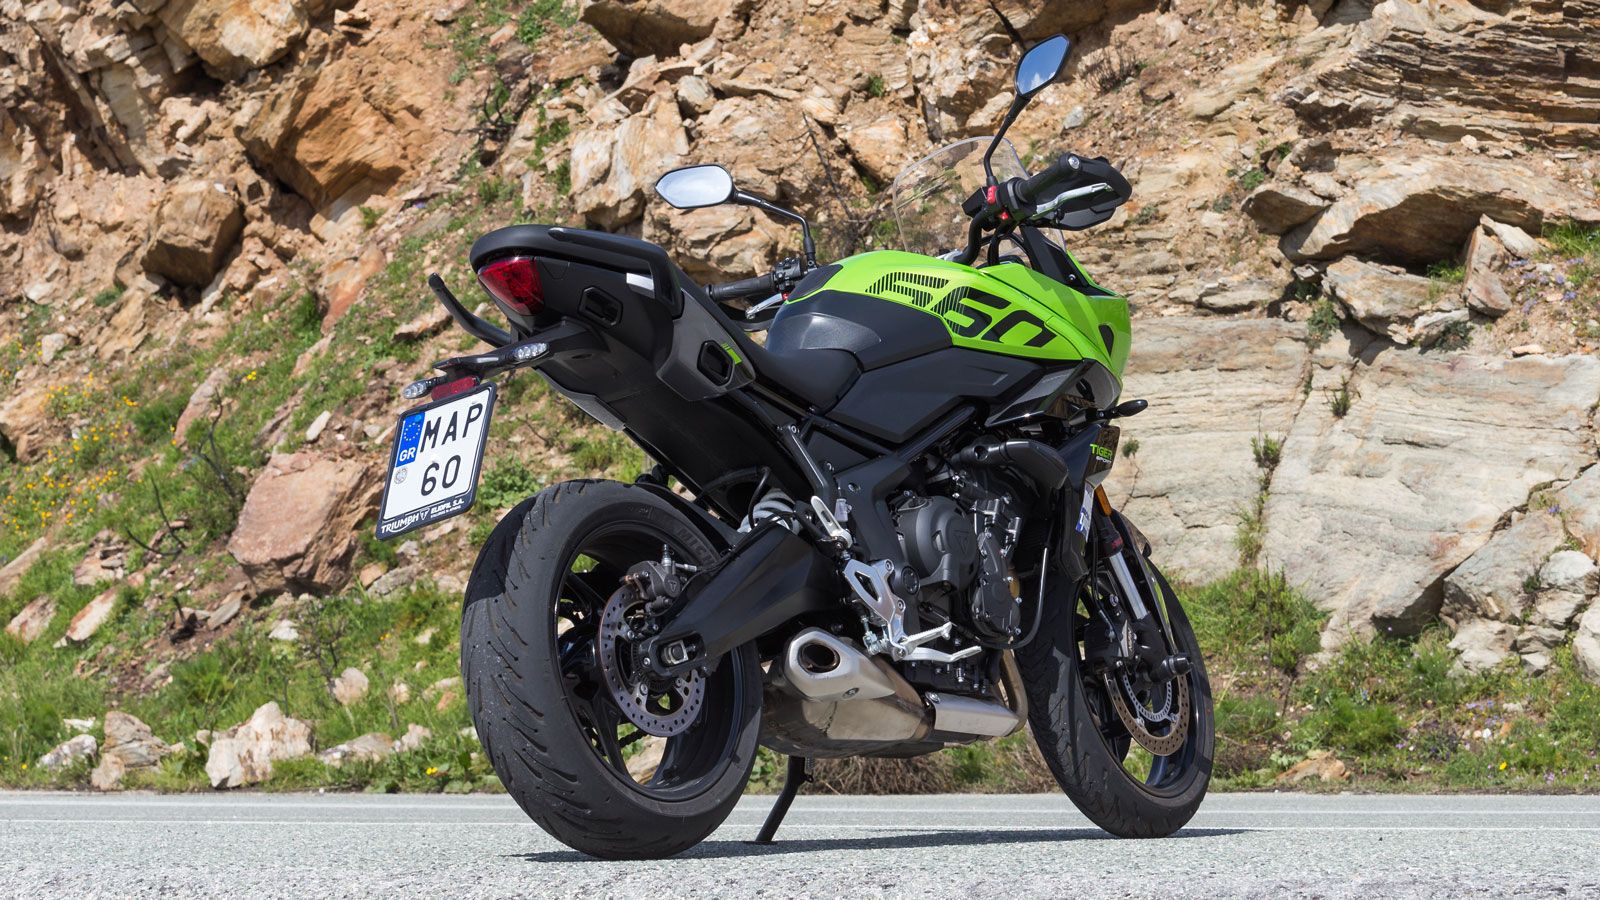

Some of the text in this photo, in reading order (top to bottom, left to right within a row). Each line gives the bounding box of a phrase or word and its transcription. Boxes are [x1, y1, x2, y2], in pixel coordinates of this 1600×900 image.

[420, 403, 483, 453] MAP
[399, 447, 416, 462] GR
[1089, 443, 1113, 460] TIGER
[421, 454, 461, 496] 60
[381, 513, 420, 534] TRIUMPH
